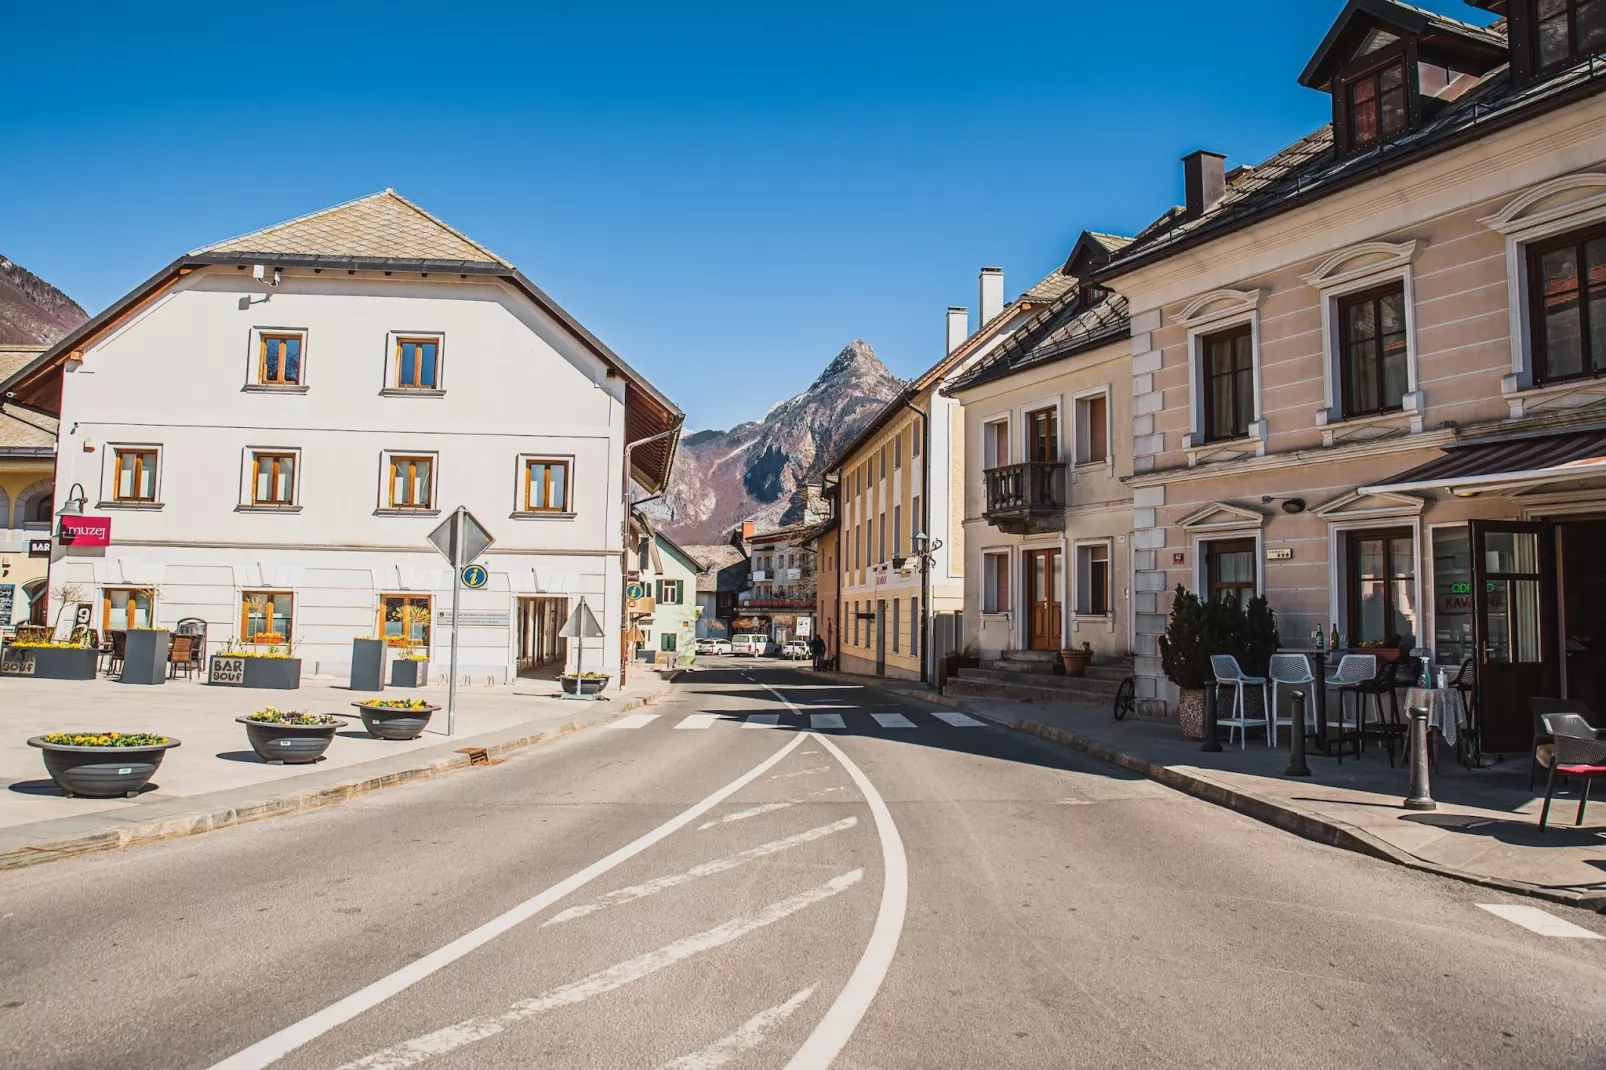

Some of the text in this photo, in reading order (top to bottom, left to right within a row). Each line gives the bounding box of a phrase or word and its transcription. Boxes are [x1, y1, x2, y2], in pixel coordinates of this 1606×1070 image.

[68, 526, 106, 539] muzej
[32, 543, 50, 551] BAR
[214, 660, 242, 672] BAR
[213, 672, 242, 681] gouf
